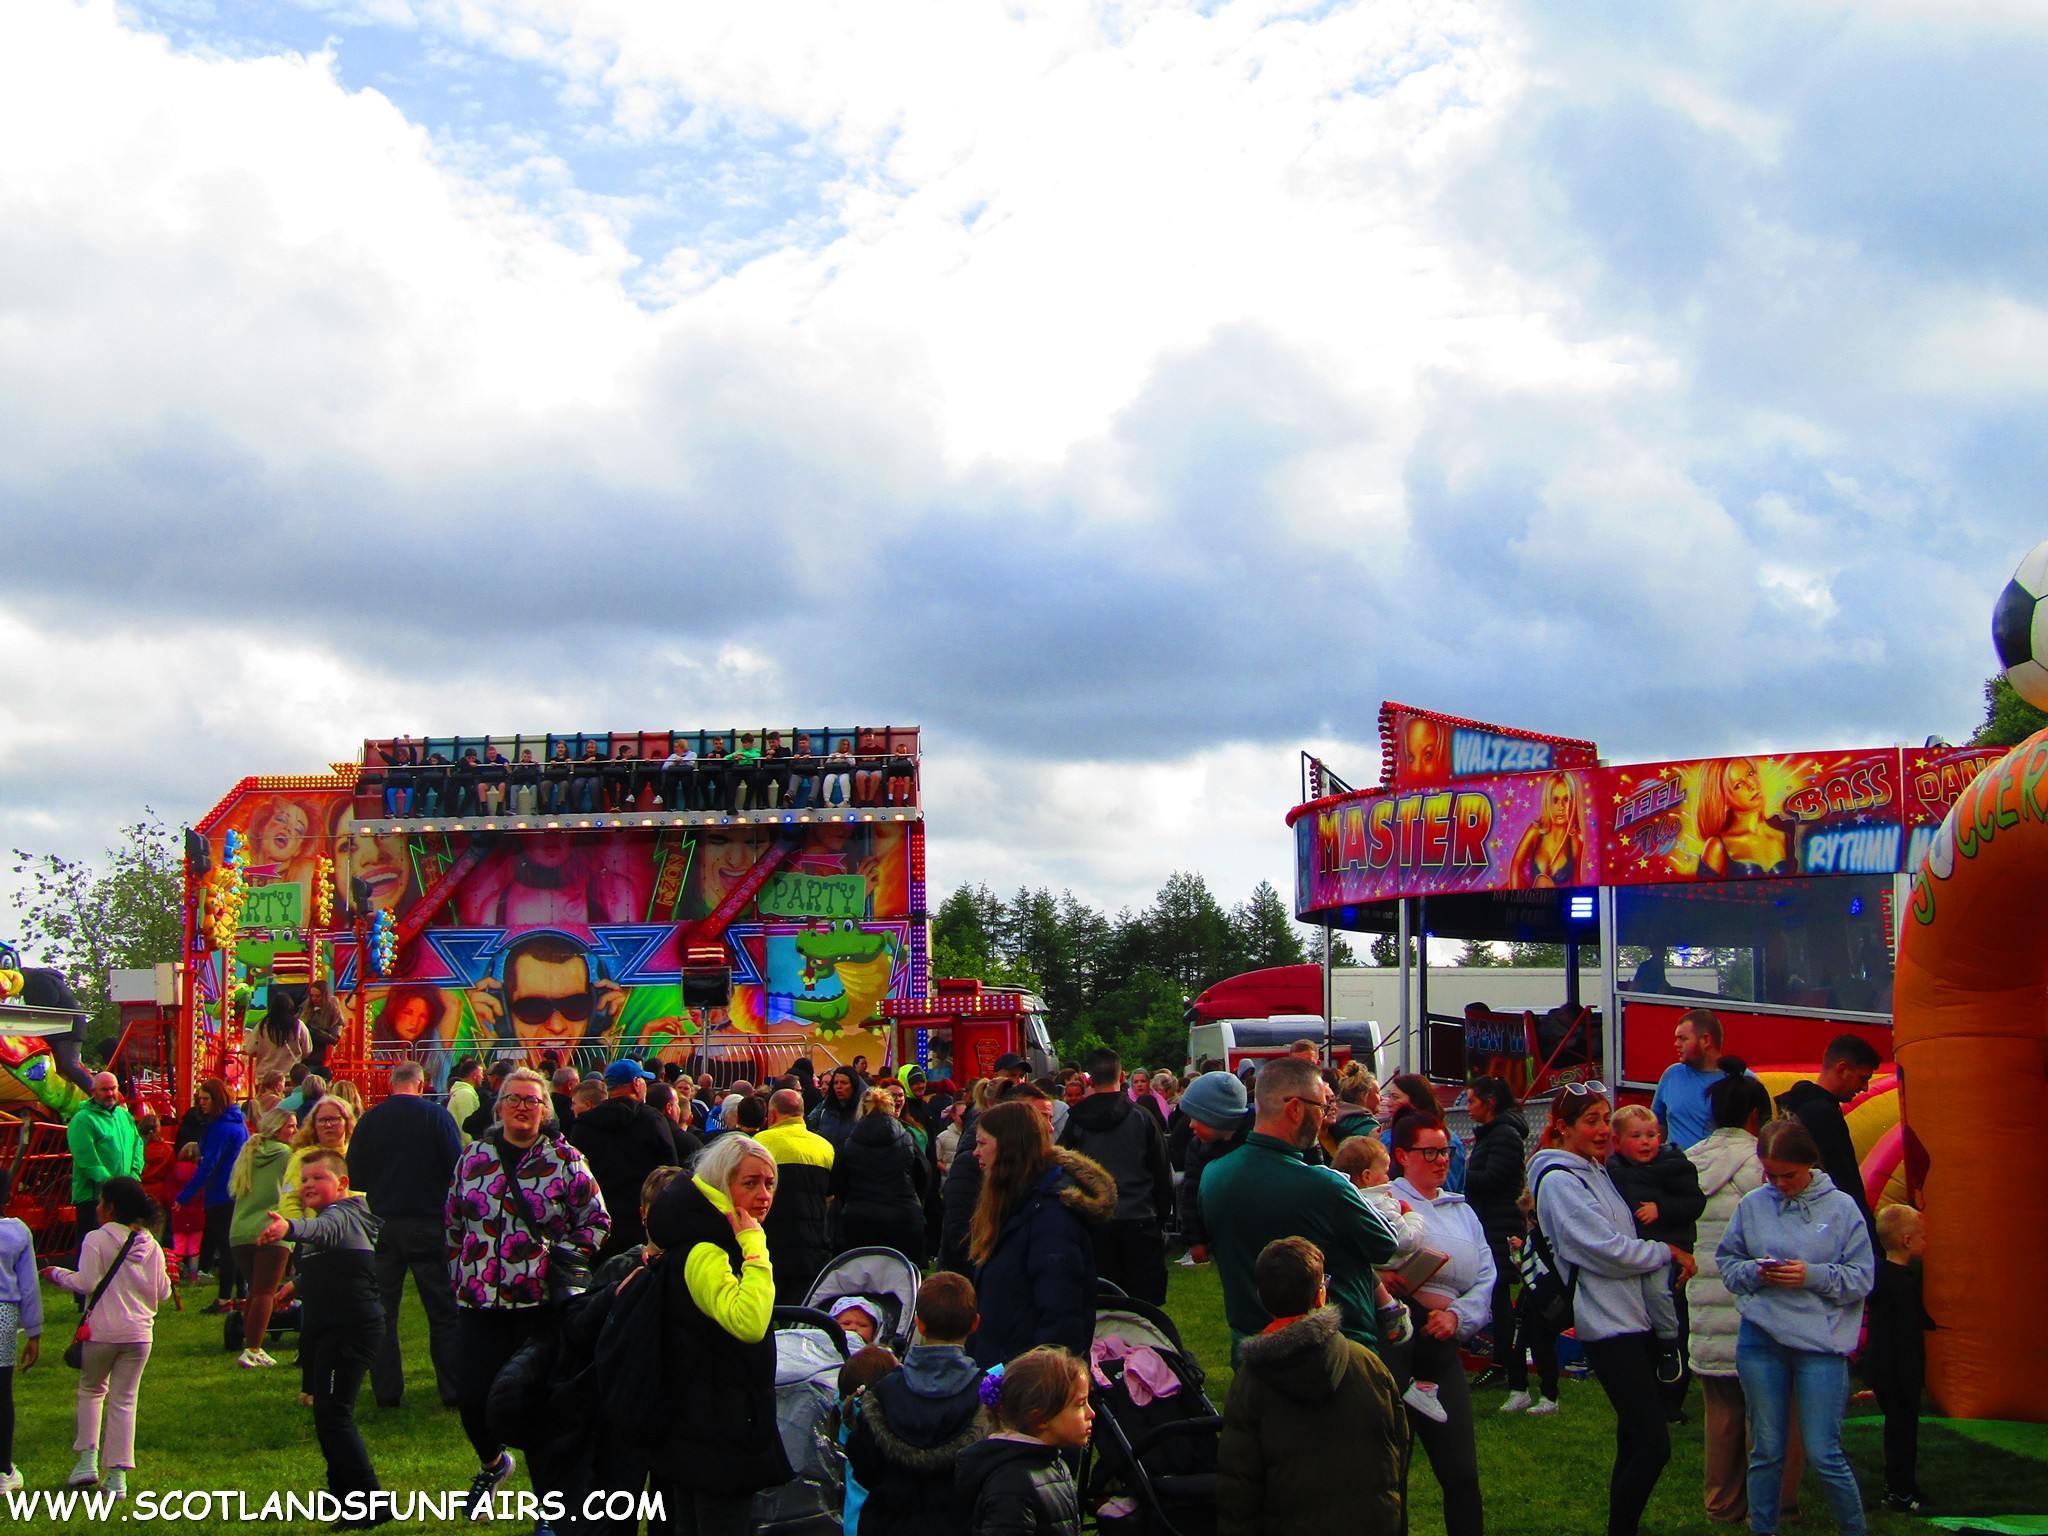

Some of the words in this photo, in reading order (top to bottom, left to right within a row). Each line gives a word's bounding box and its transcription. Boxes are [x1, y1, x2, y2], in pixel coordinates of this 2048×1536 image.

[1454, 732, 1548, 771] WALTZER
[1614, 775, 1687, 831] FEEL
[1787, 763, 1893, 822] BASS
[1914, 757, 2000, 804] DAN
[1317, 791, 1493, 874] MASTER
[1632, 815, 1682, 855] The
[771, 876, 856, 912] PARTY
